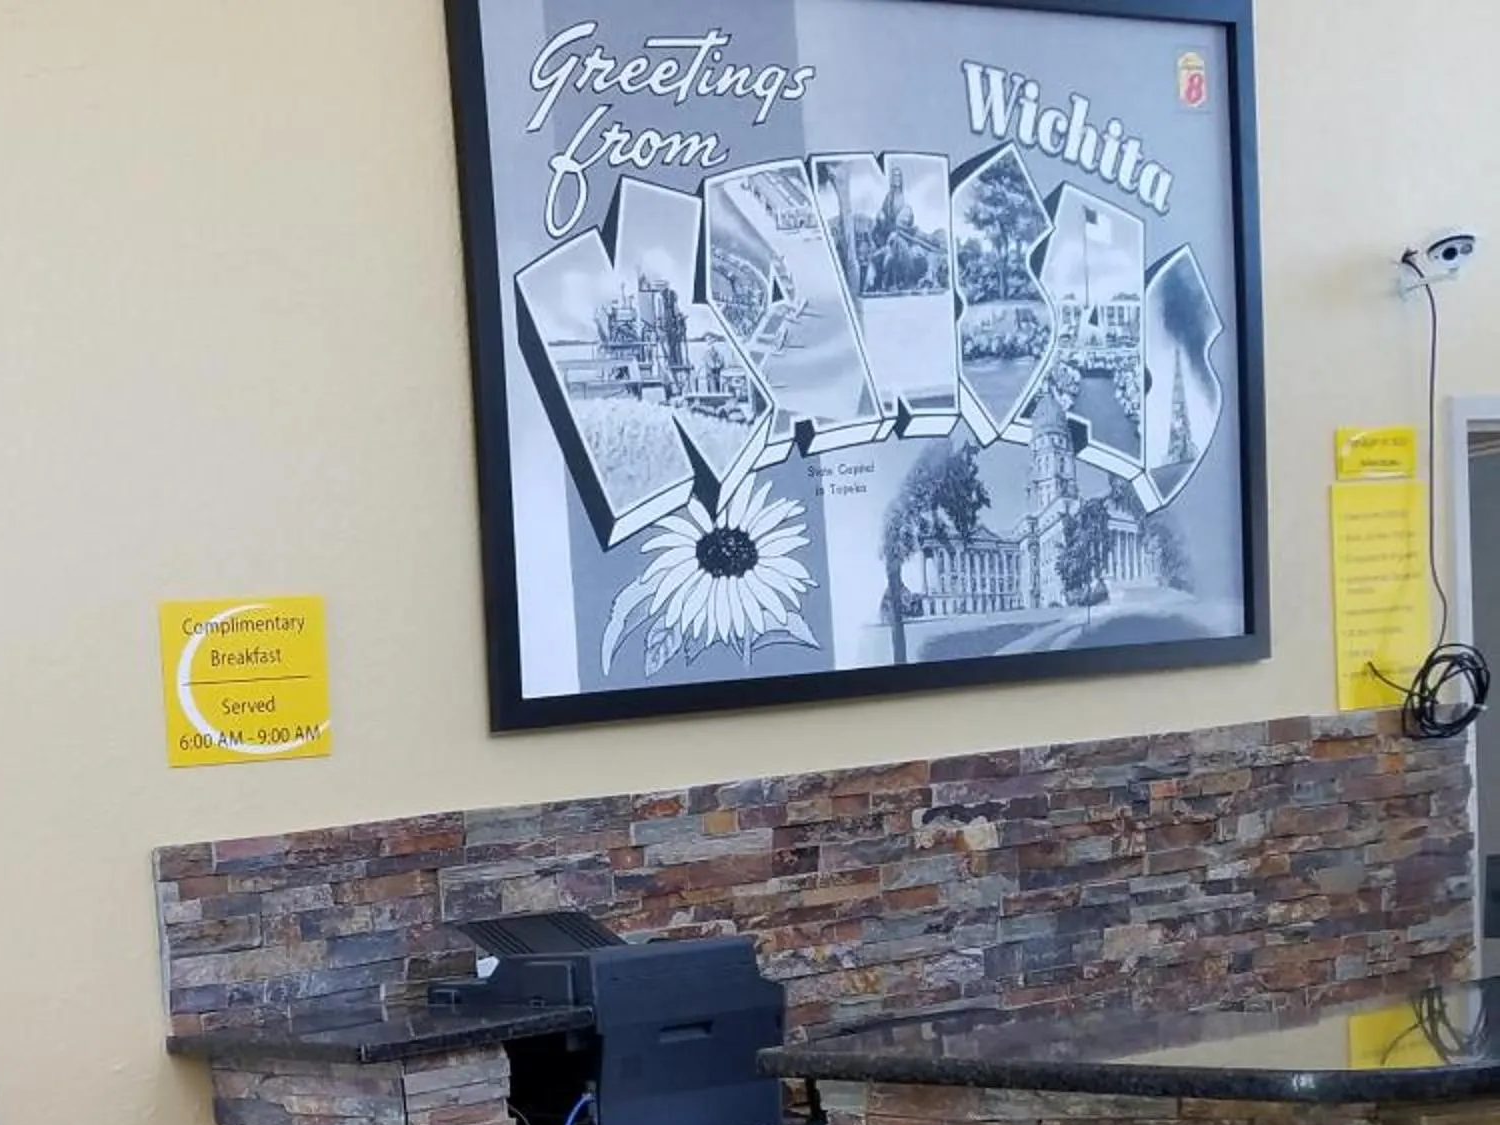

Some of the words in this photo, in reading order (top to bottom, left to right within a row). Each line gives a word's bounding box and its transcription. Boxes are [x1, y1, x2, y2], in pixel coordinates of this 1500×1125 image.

[525, 19, 817, 132] Greetings
[544, 103, 731, 240] from
[960, 59, 1175, 216] Wichita
[514, 142, 1224, 552] KANSAS
[181, 615, 306, 637] Complimentary
[210, 647, 282, 667] Breakfast
[179, 732, 213, 751] 6:00
[217, 730, 244, 748] AM
[257, 727, 291, 745] 9:00
[294, 725, 322, 742] AM
[221, 696, 277, 715] Served
